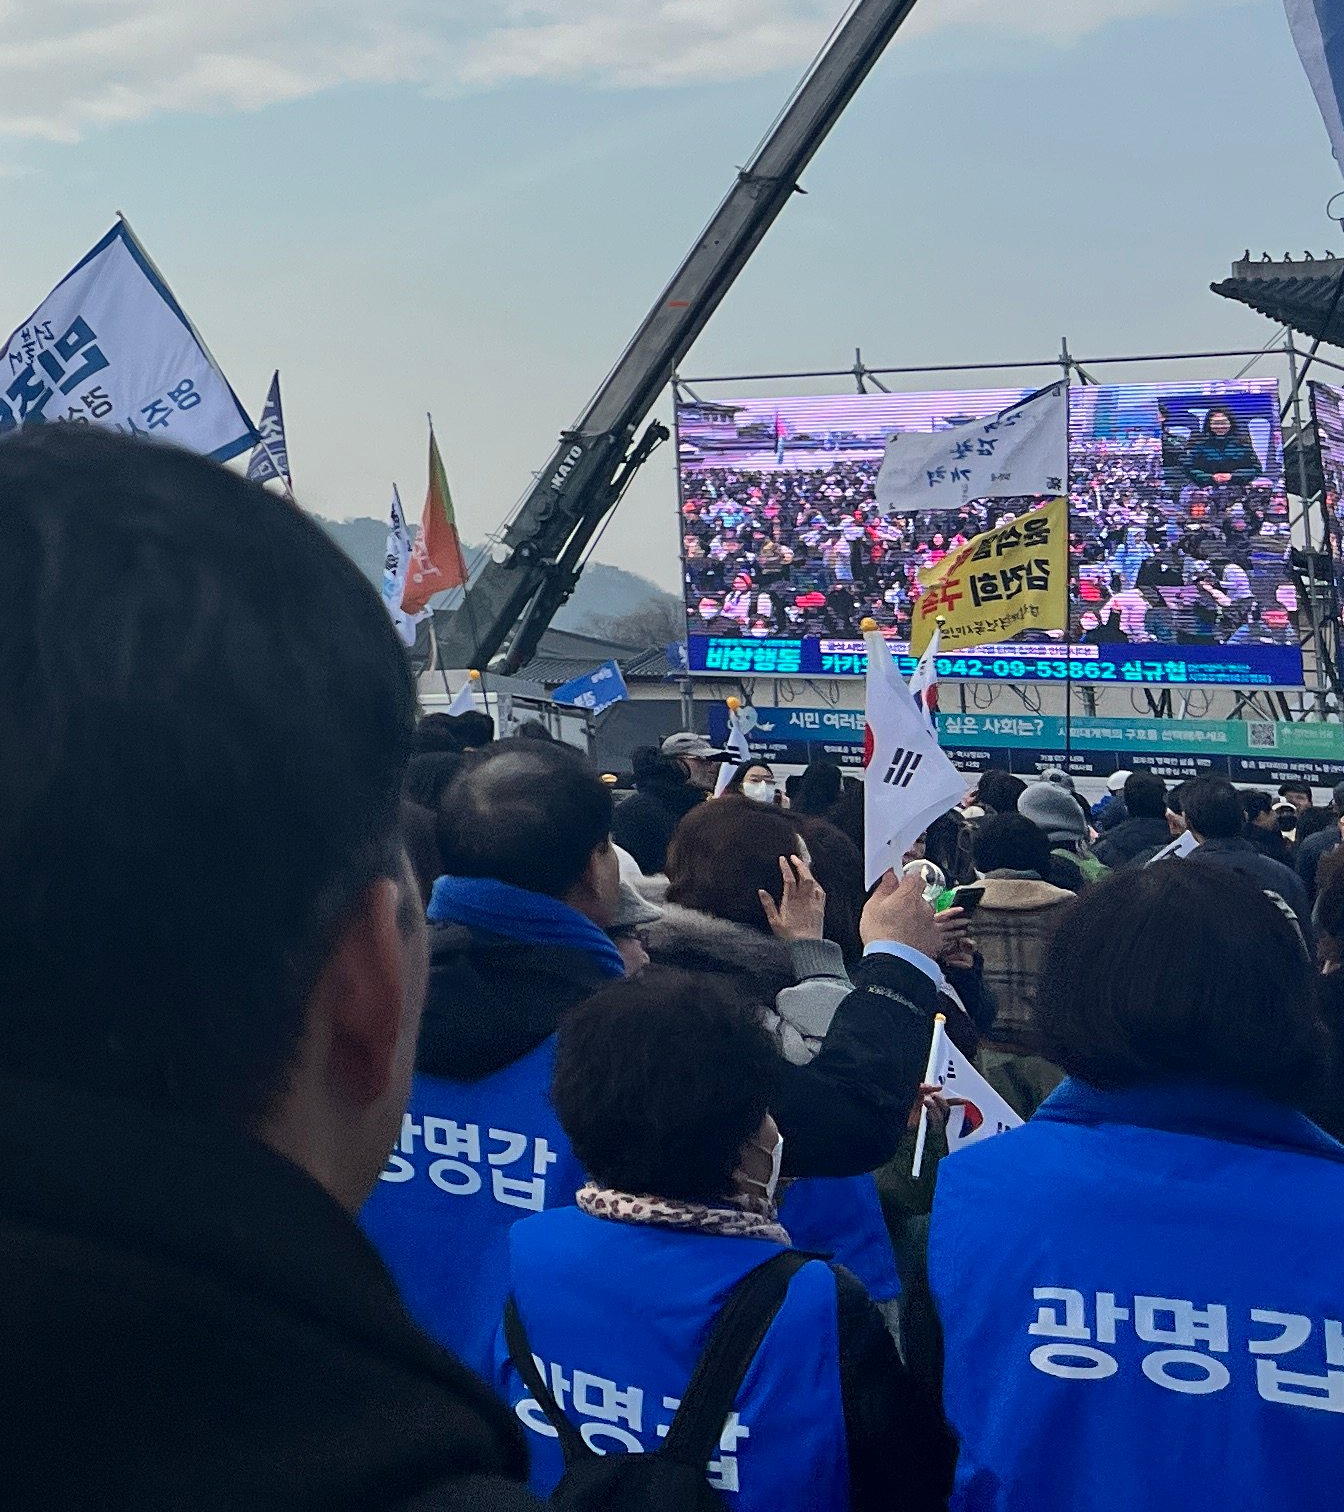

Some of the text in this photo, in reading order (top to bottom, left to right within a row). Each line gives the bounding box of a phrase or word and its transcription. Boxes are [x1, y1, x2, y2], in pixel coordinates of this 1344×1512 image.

[705, 646, 802, 672] 비상행동
[935, 658, 1117, 680] 942-09-53862
[789, 711, 820, 729] 시민
[944, 717, 1045, 736] 싶은 사회는?
[1028, 1285, 1344, 1413] 광명갑
